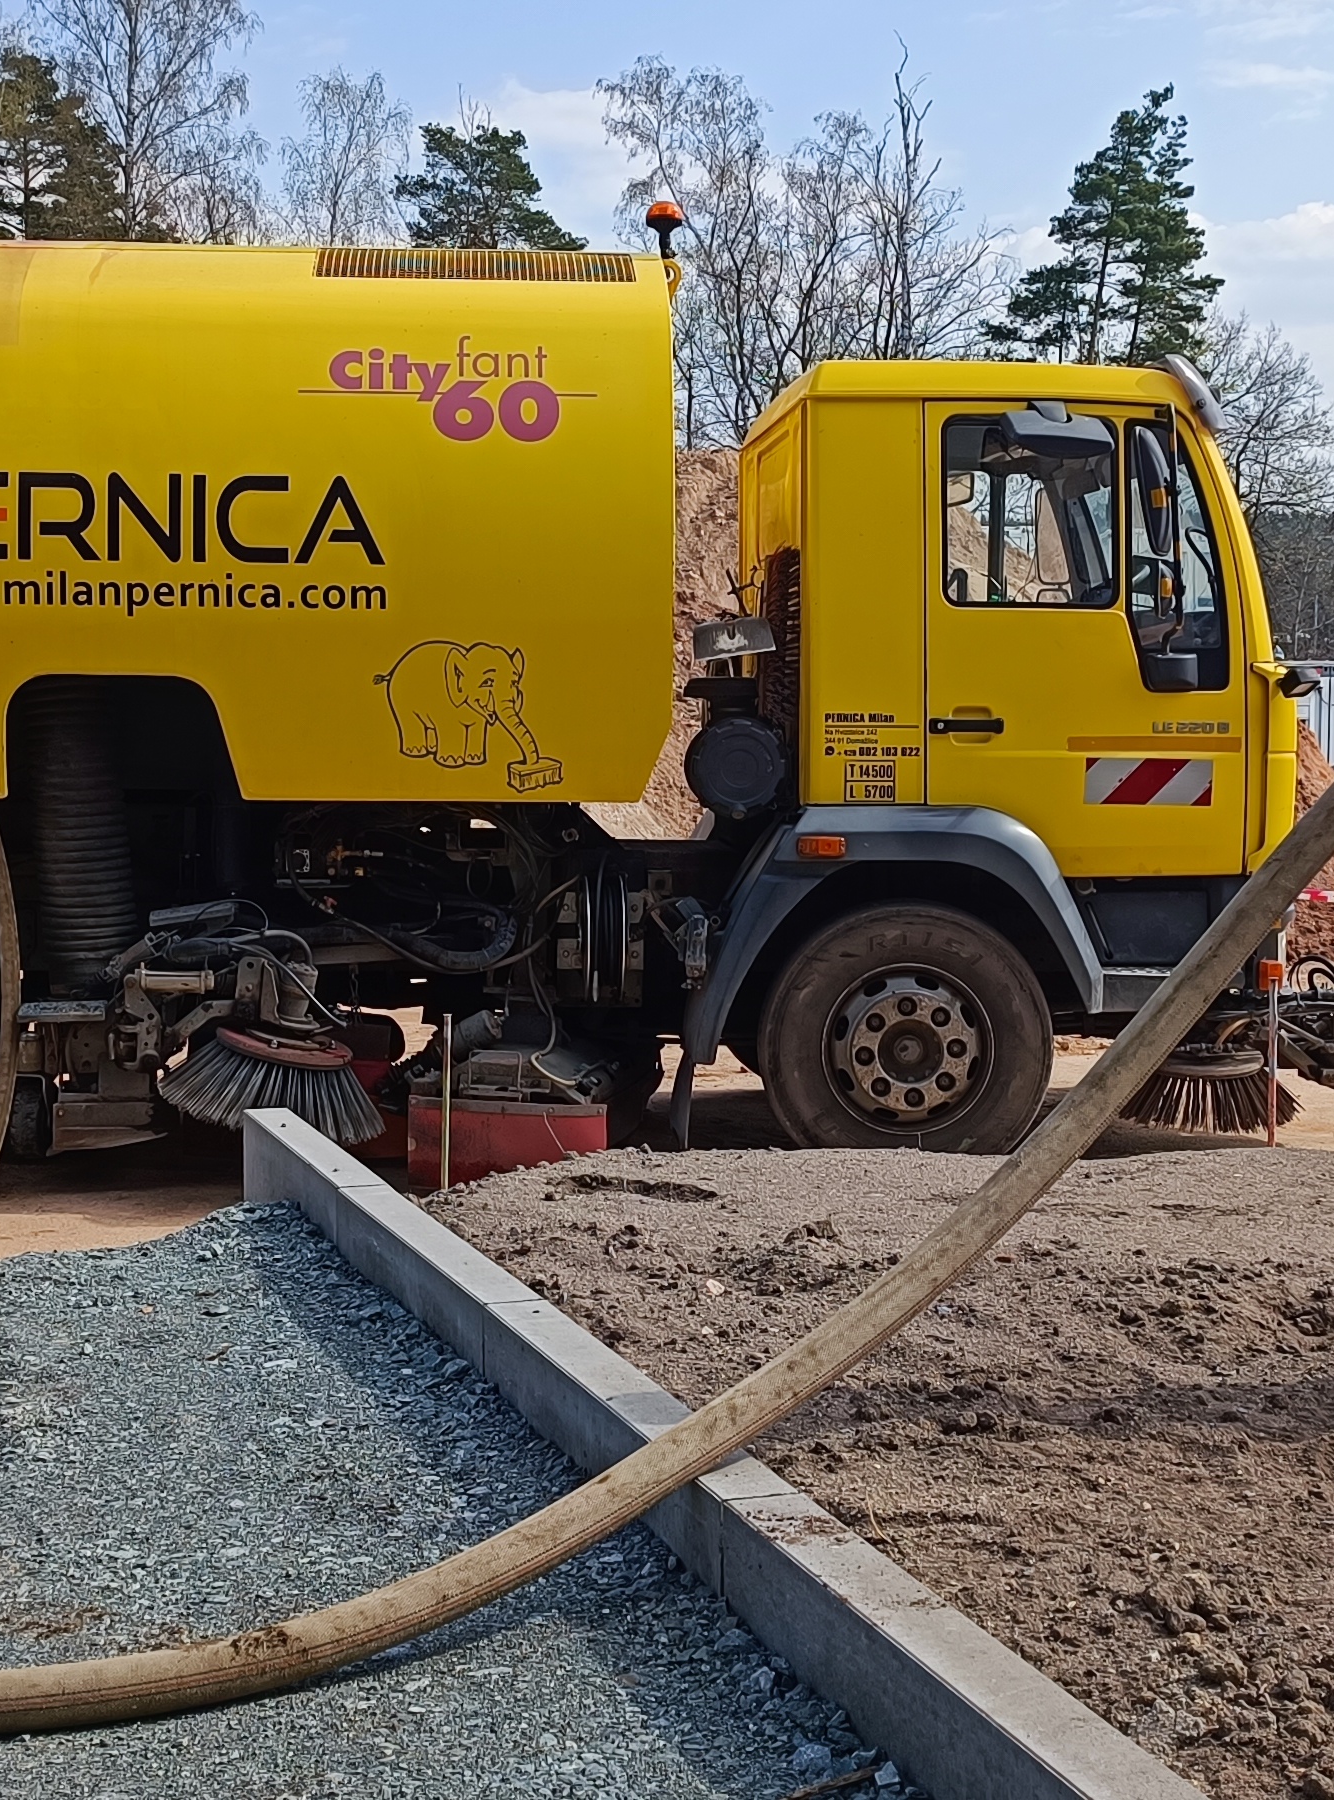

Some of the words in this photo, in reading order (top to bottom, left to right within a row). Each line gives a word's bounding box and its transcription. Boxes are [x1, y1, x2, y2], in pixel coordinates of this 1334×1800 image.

[329, 348, 451, 401] City
[457, 336, 547, 378] fant
[433, 380, 560, 442] 60
[1152, 721, 1174, 734] LE
[1176, 721, 1214, 734] 220
[849, 764, 856, 778] T
[858, 764, 894, 779] 14500
[850, 785, 856, 798] L
[864, 785, 894, 799] 5700
